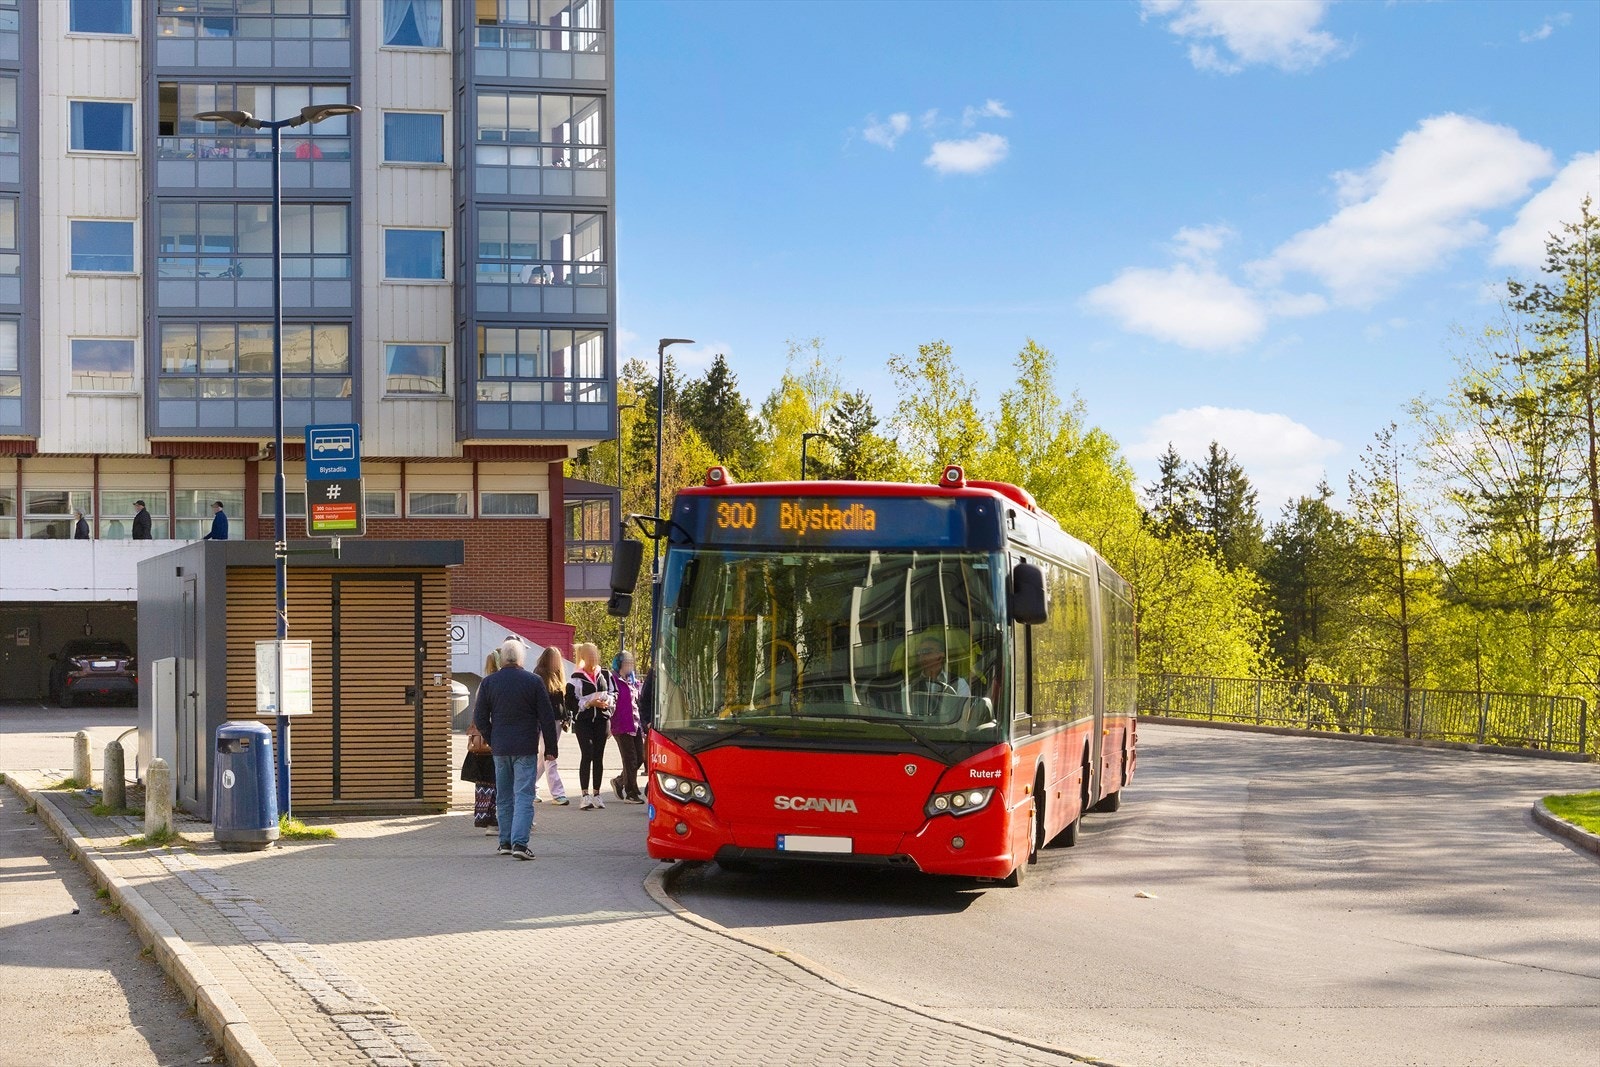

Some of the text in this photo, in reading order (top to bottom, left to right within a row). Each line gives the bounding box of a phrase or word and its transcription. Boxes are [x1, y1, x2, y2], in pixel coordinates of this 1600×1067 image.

[717, 502, 876, 535] 300 Blystadlia
[652, 754, 668, 764] 1410
[970, 769, 1002, 778] Ruter#
[774, 796, 859, 814] SCANIA
